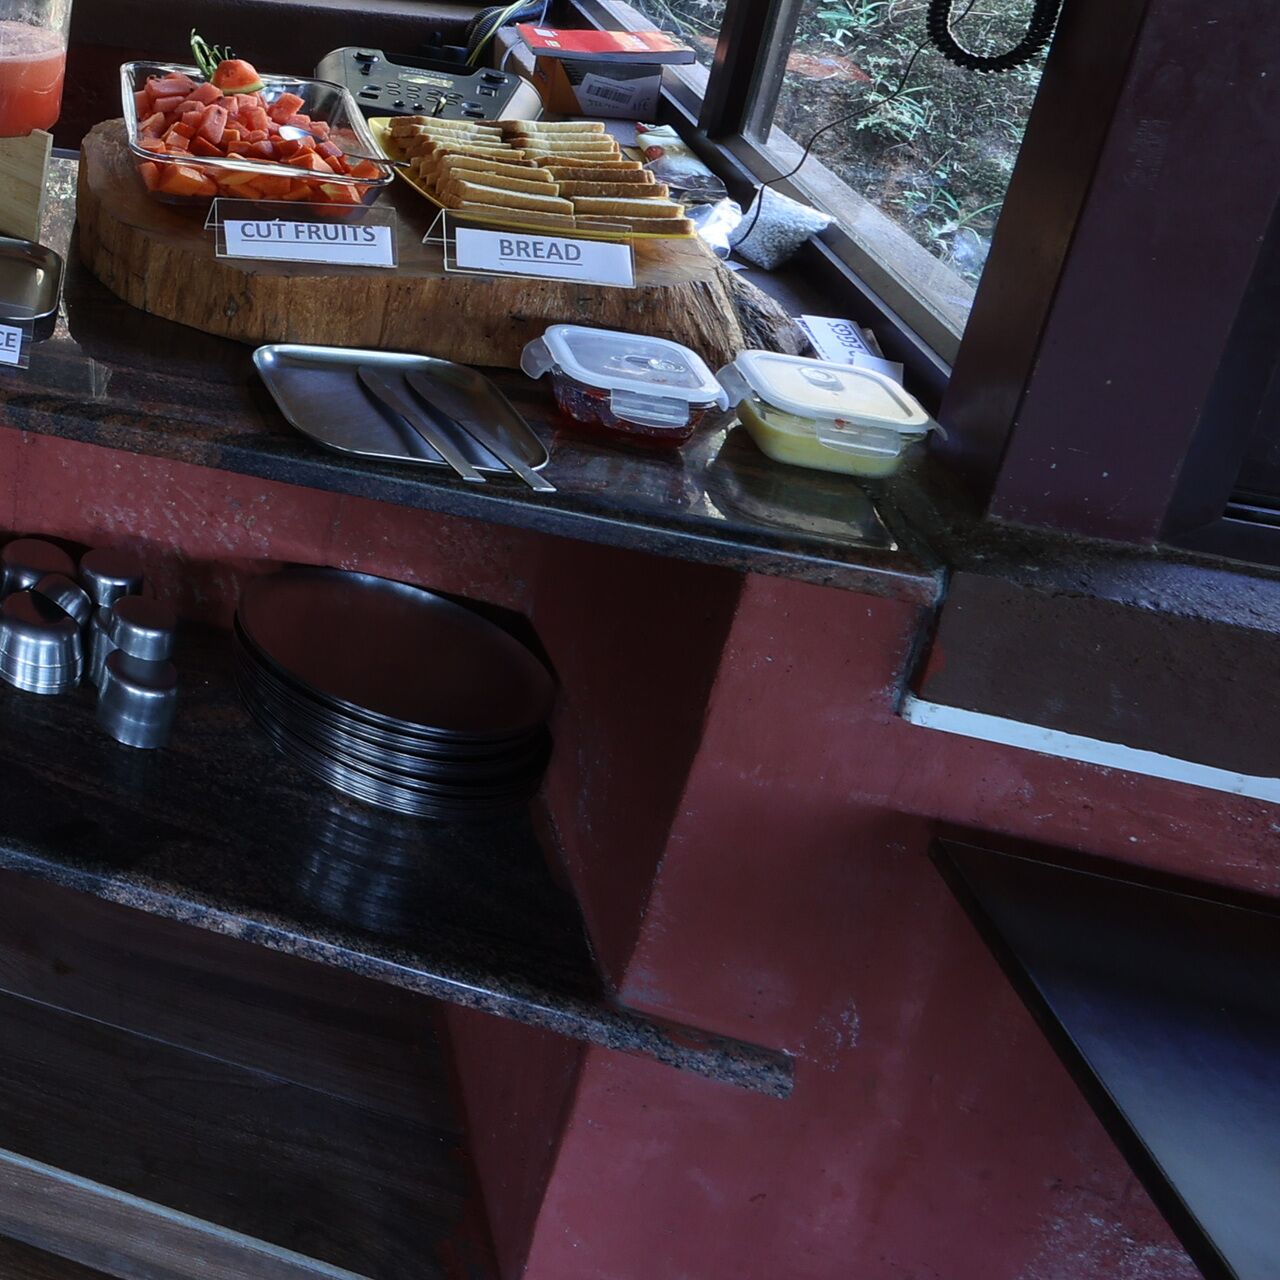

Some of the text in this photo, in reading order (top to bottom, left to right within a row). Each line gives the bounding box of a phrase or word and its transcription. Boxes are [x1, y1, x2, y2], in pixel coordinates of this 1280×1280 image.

[240, 222, 376, 242] CUT FRUITS
[499, 238, 582, 261] BREAD
[826, 322, 864, 351] EGGS
